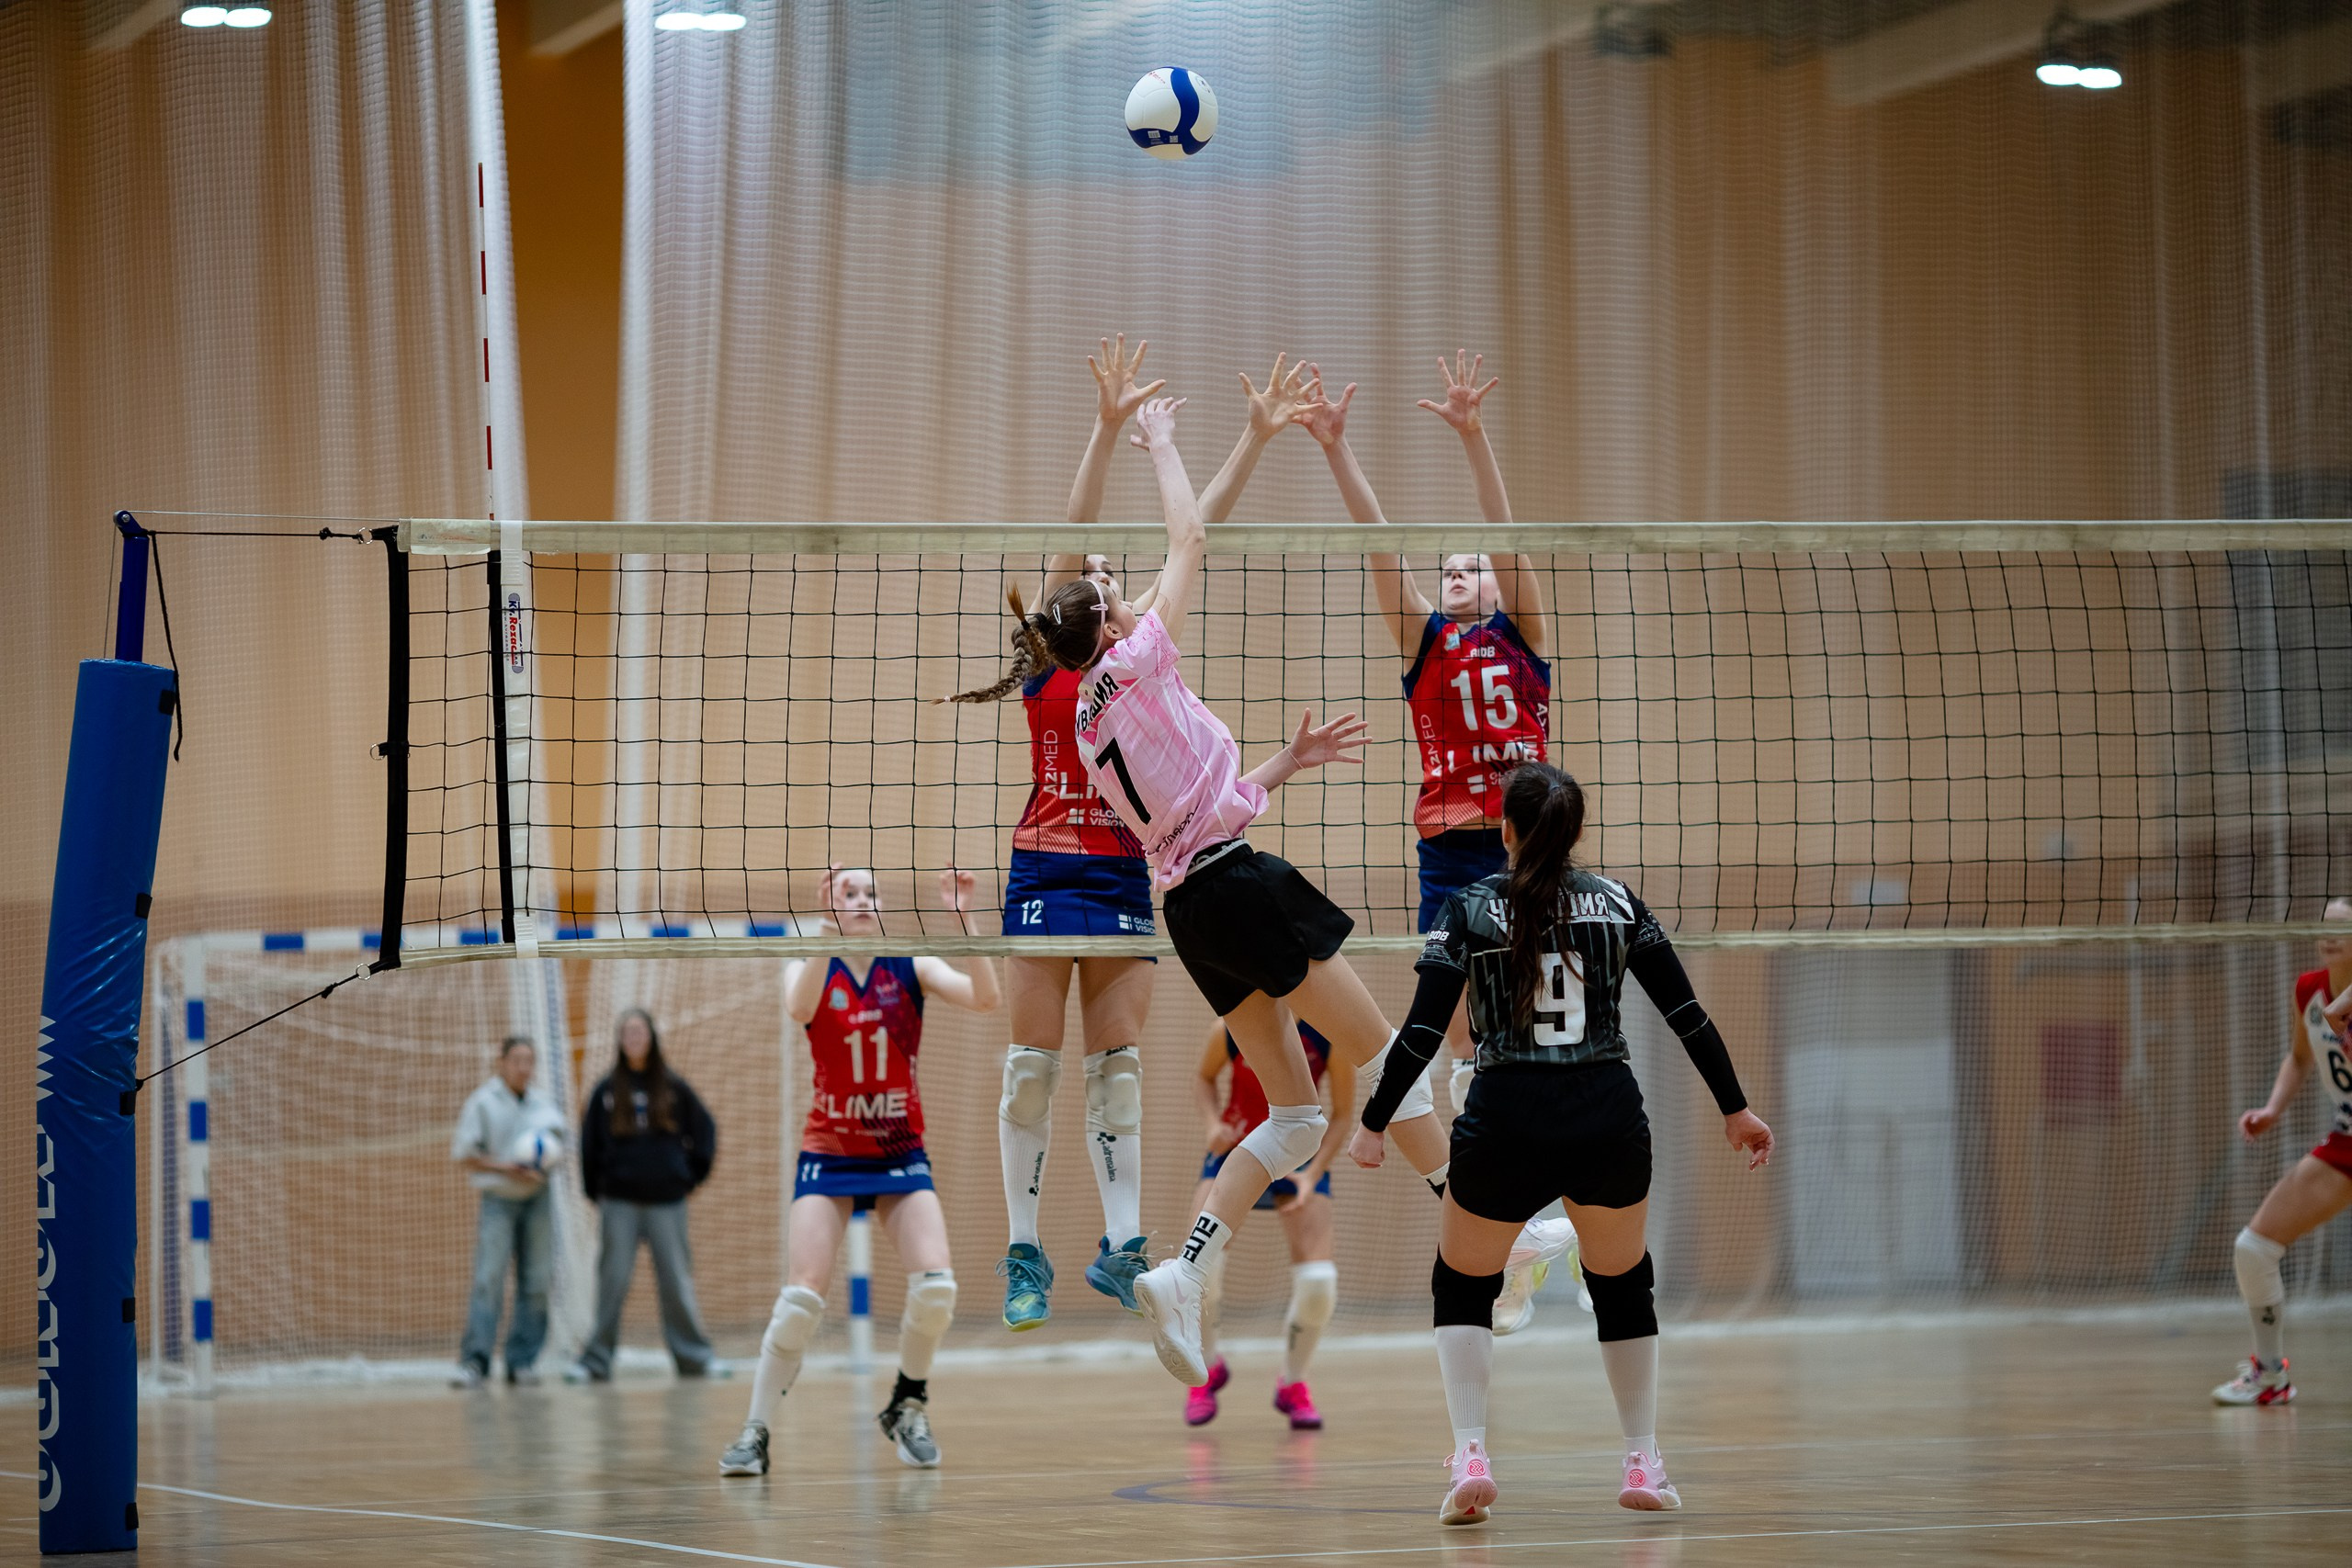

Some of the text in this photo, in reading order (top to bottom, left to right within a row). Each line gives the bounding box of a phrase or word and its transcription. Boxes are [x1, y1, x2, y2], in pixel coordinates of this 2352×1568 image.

[1451, 664, 1517, 731] 15
[1043, 729, 1058, 796] AZMED
[1420, 714, 1442, 777] AZMED
[1095, 737, 1152, 825] 7
[1022, 899, 1044, 925] 12
[1532, 951, 1587, 1046] 9
[843, 1026, 888, 1084] 11
[2328, 1050, 2352, 1093] 6
[827, 1089, 909, 1120] LIME
